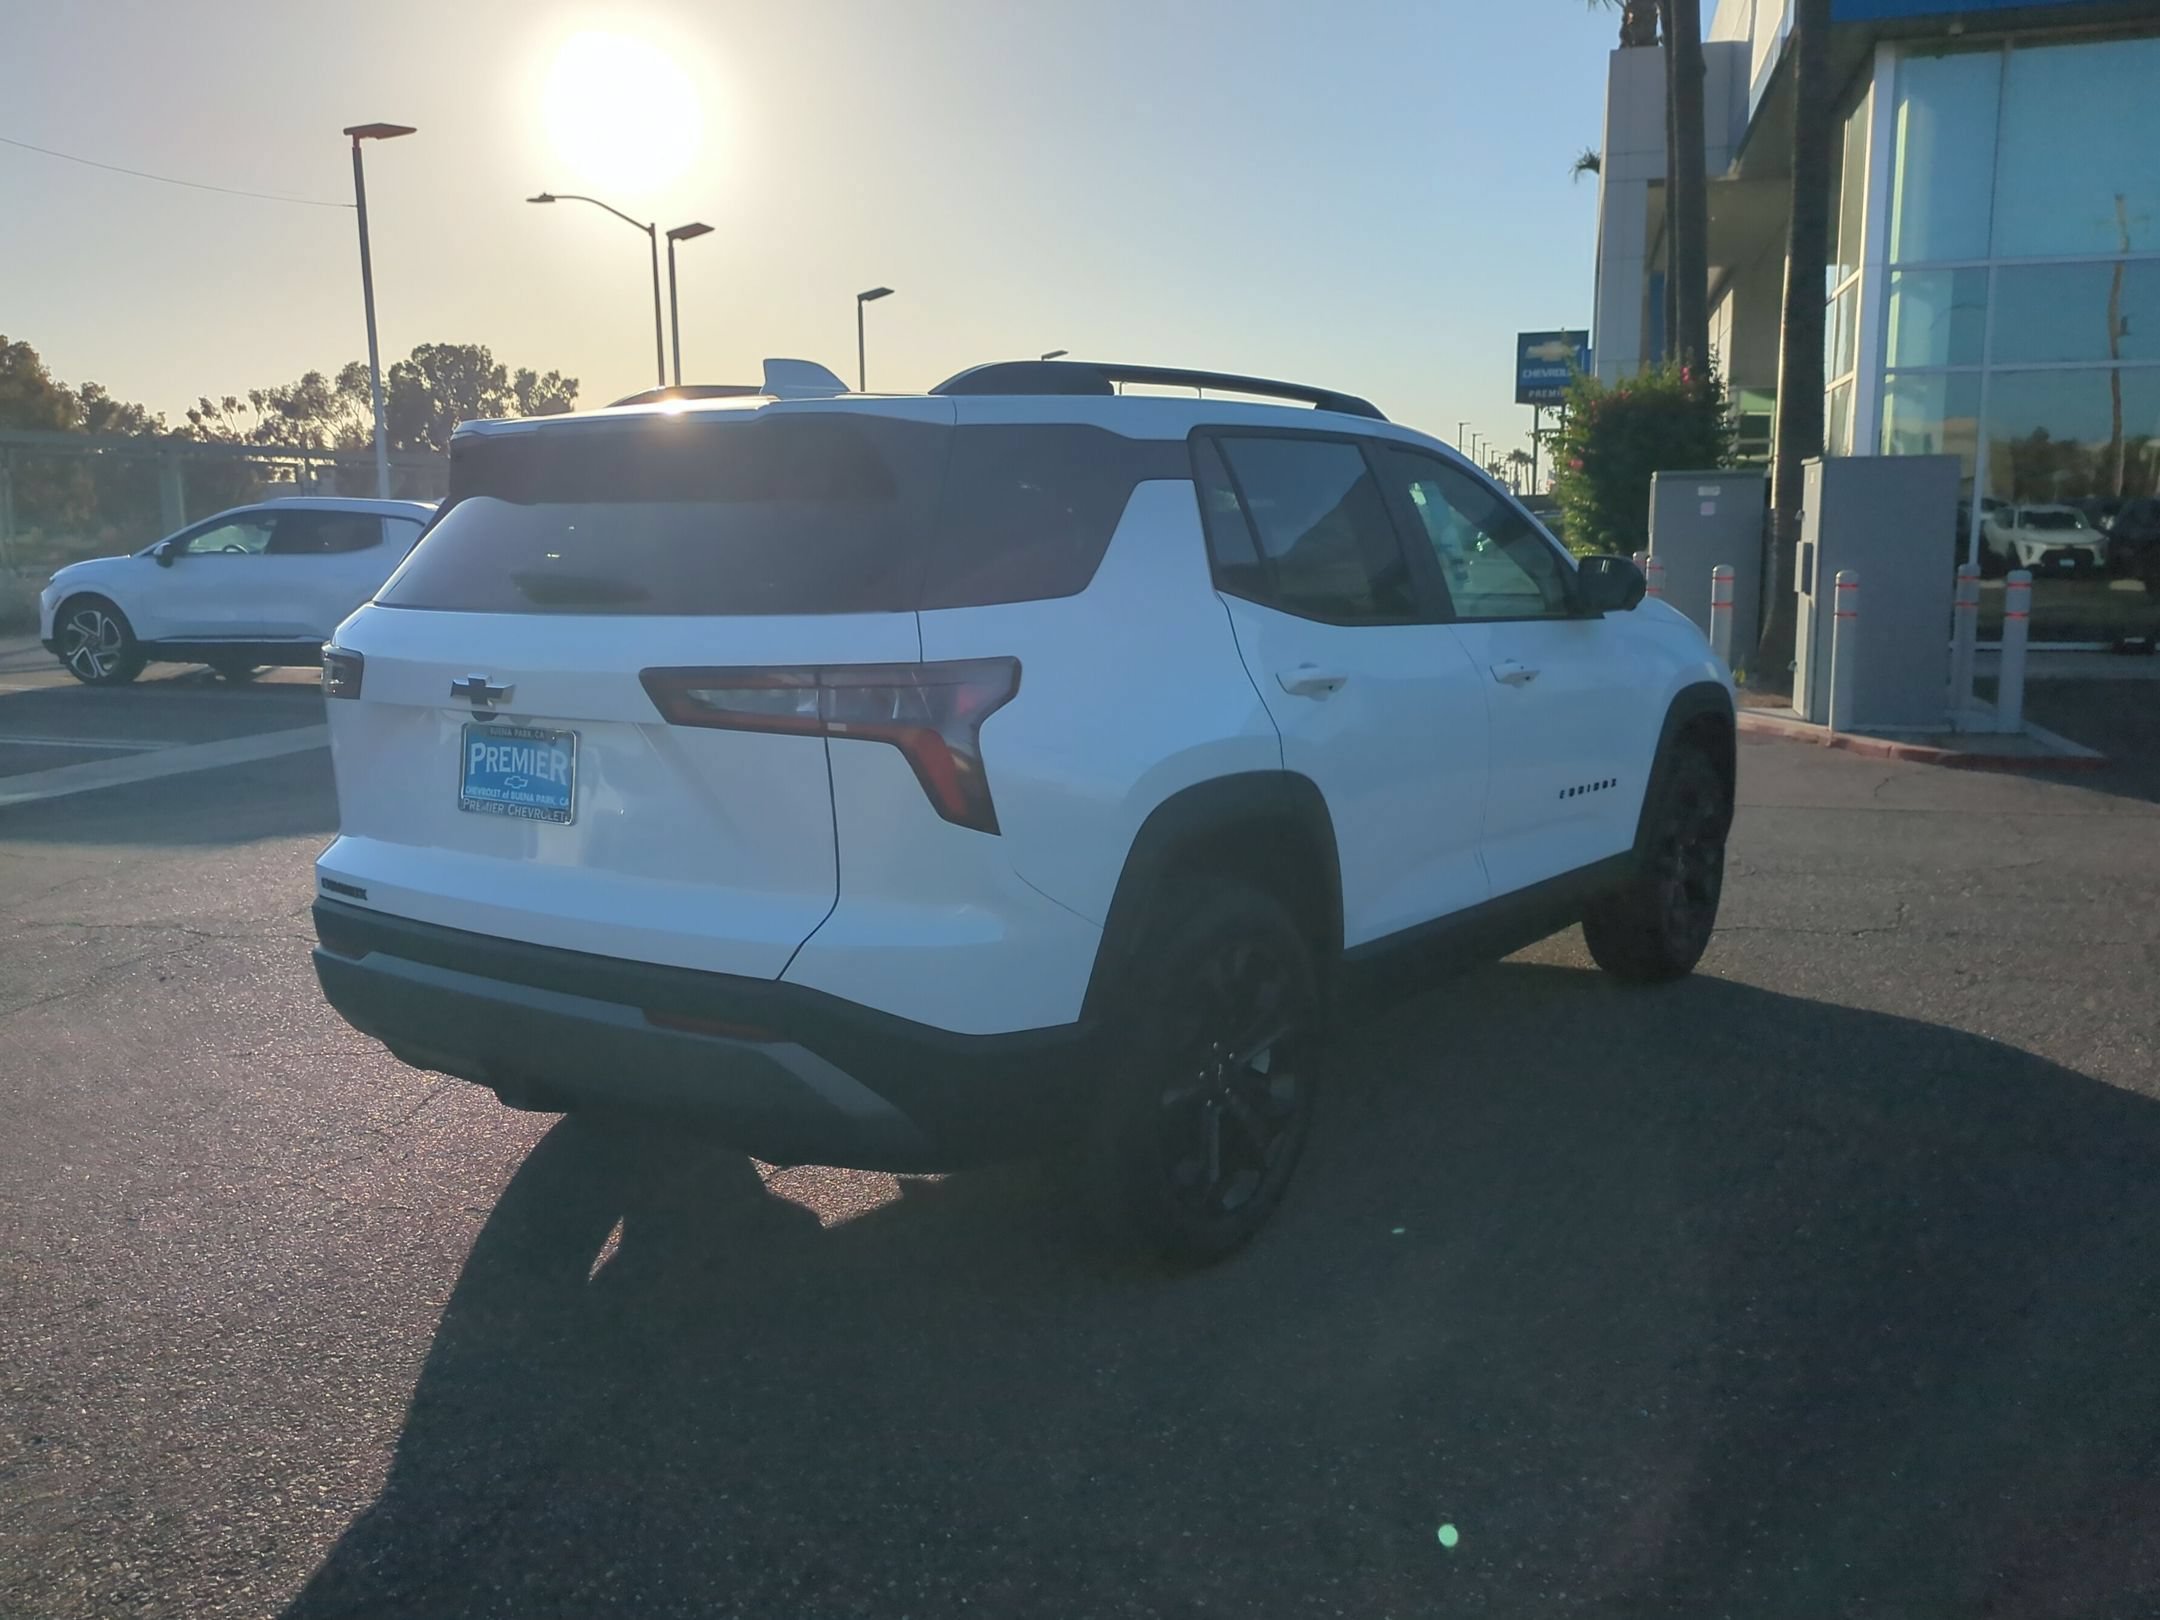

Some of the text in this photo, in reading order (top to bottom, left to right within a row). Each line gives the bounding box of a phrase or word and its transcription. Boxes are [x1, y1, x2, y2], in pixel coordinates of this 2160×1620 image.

[1522, 368, 1570, 378] CHEVROL
[470, 742, 568, 786] PREMIER
[465, 786, 501, 798] CHEVROLET
[510, 791, 534, 802] BUENA
